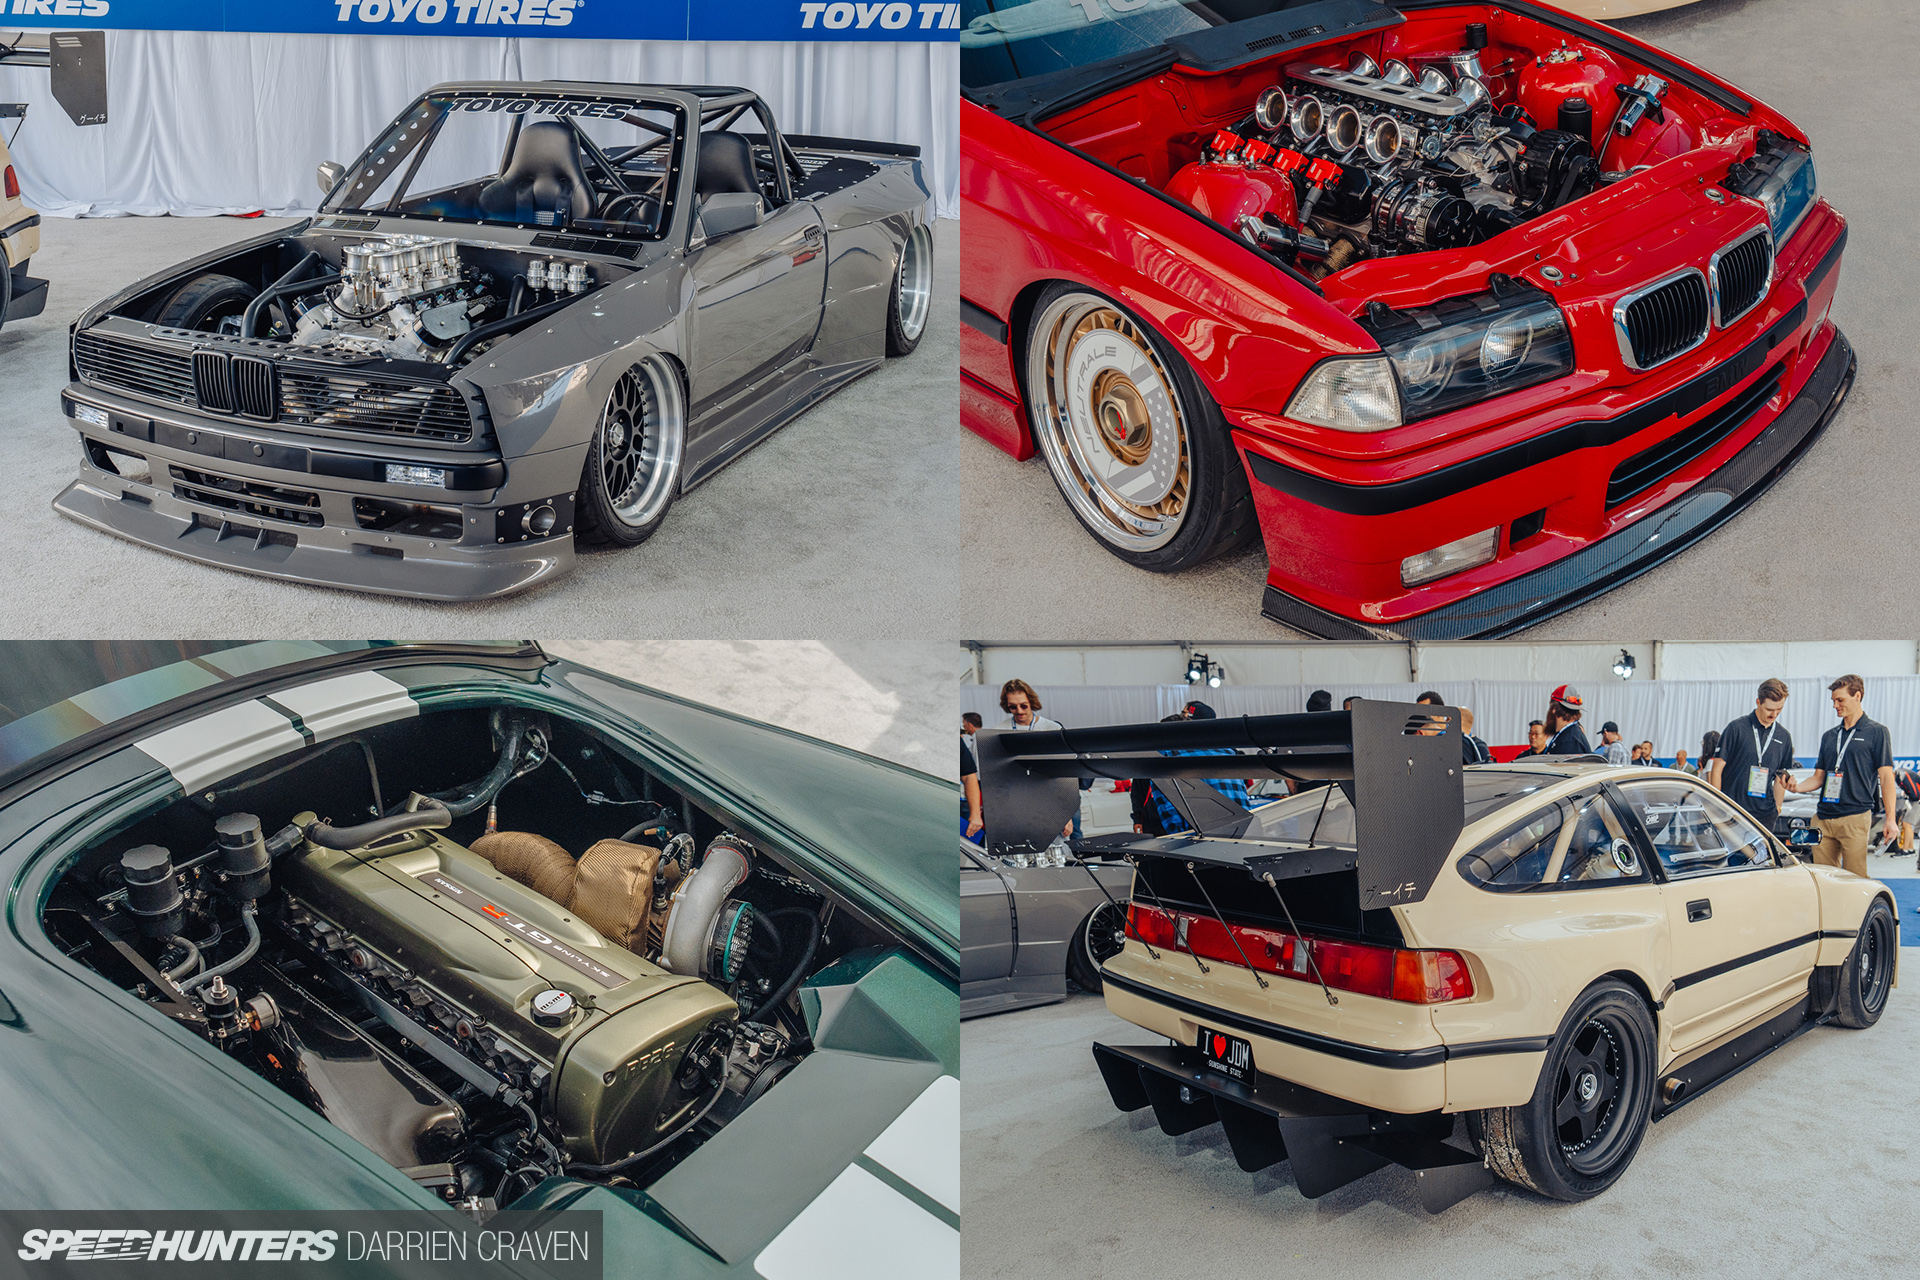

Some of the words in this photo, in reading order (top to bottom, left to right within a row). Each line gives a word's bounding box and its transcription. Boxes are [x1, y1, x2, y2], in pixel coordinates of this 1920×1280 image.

[0, 0, 110, 17] IRES
[335, 0, 448, 24] TOYO
[799, 2, 912, 30] TOYO
[447, 97, 536, 115] TOYO
[533, 99, 634, 120] TIRES
[1704, 354, 1750, 400] BMW
[1076, 345, 1117, 453] NEUTRALE
[552, 944, 611, 979] SKYLINE
[1203, 1030, 1211, 1056] I
[1227, 1040, 1249, 1070] JDM
